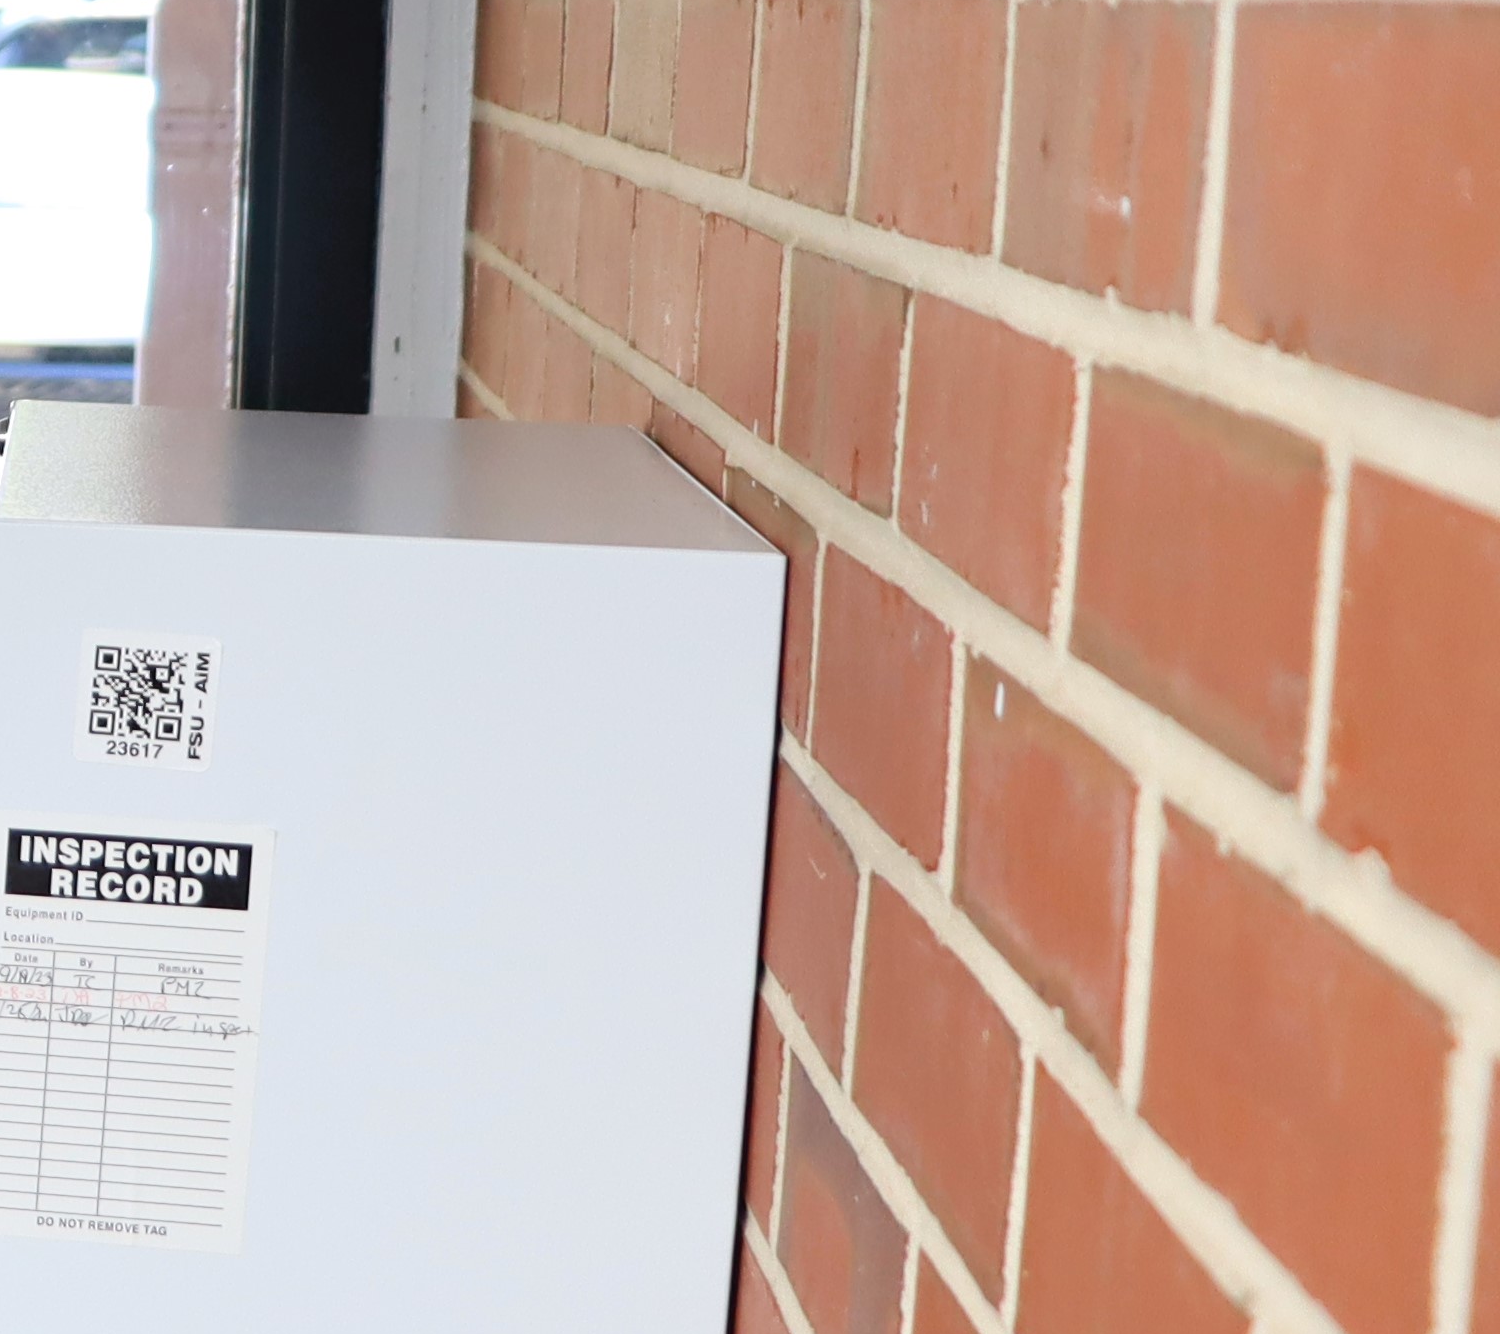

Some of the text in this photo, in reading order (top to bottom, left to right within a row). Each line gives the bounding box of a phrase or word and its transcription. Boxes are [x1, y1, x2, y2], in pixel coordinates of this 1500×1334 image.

[188, 716, 204, 759] FSU
[106, 741, 163, 759] 23617
[19, 836, 238, 876] INSPECTION
[51, 868, 203, 904] RECORD
[5, 907, 83, 921] Equipment ID
[4, 932, 54, 944] Location
[14, 953, 204, 975] Date By Remarks
[37, 1217, 167, 1236] DO NOT REMOVE TAG
